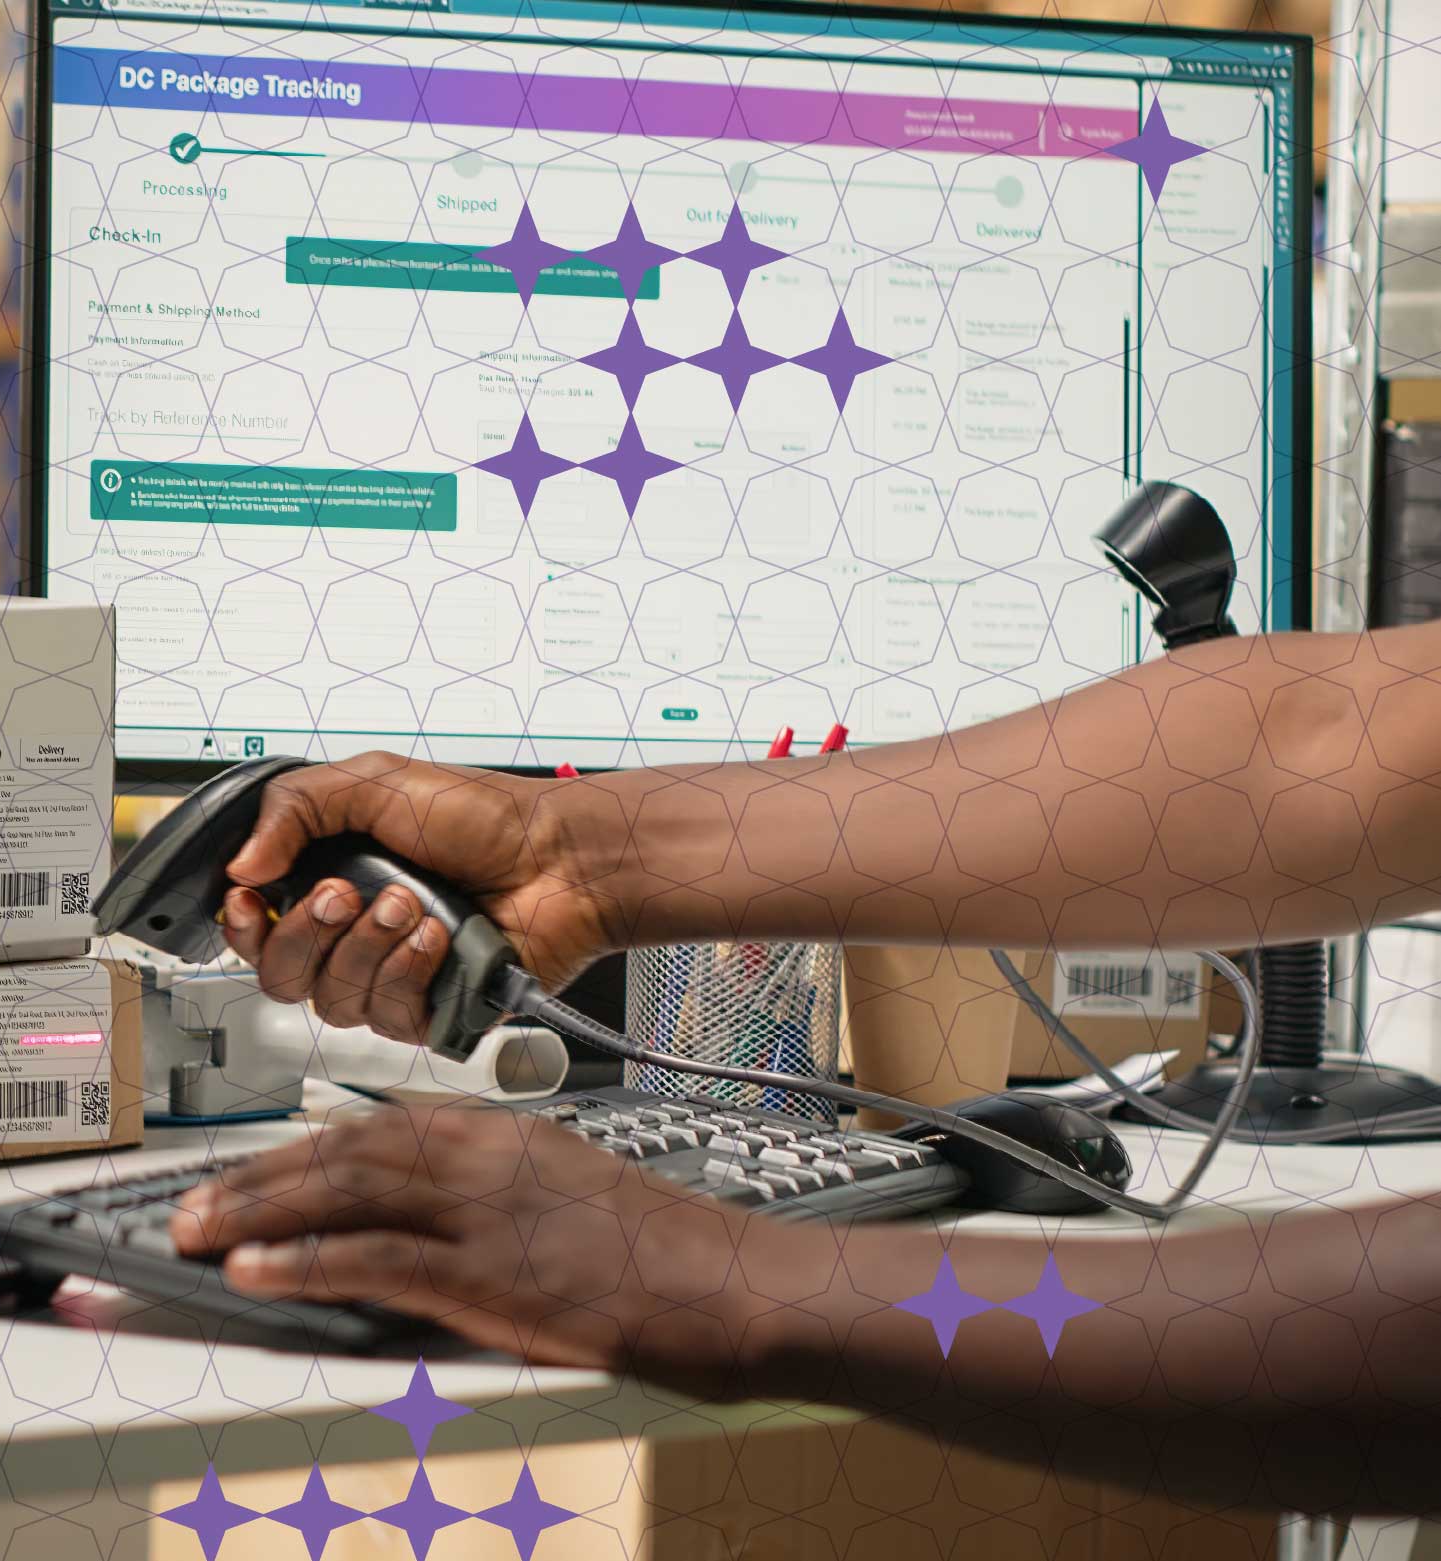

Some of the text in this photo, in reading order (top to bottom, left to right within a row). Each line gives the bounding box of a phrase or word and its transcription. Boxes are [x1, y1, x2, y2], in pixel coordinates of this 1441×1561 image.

[120, 66, 362, 106] DC Package Tracking
[143, 180, 227, 200] Processing
[436, 193, 497, 213] Shipped
[686, 207, 713, 223] Out
[89, 226, 161, 243] Check-In
[976, 222, 1042, 240] Delivered
[88, 301, 260, 319] Payment & Shipping Method
[131, 409, 147, 427] by
[154, 410, 226, 428] Reference
[38, 744, 65, 755] Delivery
